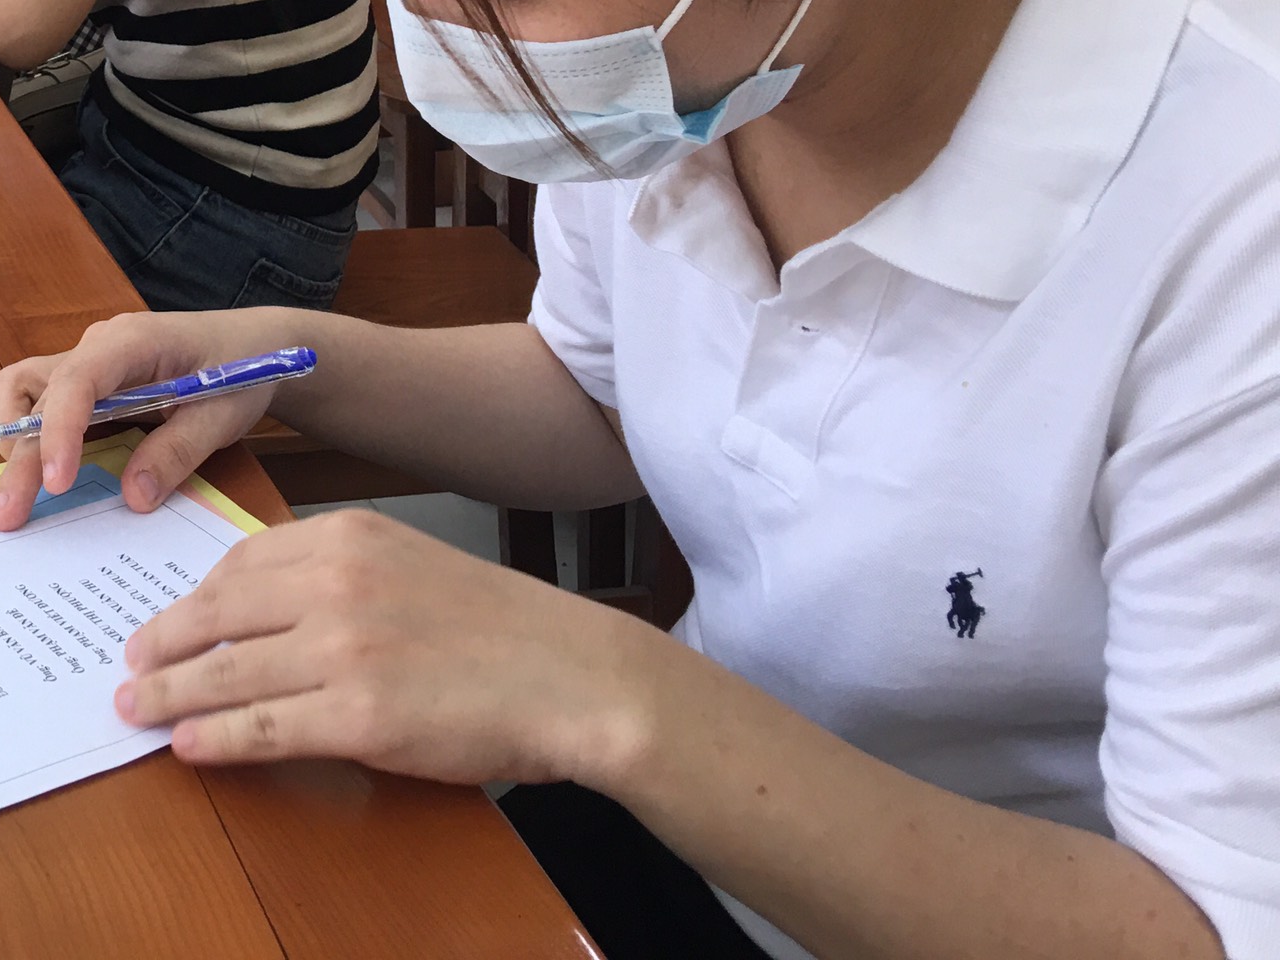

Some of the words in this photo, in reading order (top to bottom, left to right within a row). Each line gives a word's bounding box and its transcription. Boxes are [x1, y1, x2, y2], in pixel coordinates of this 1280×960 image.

[142, 570, 162, 586] VĂN
[164, 561, 190, 579] VINH
[48, 582, 88, 612] PHƯỢNG
[99, 593, 123, 613] XUÂN
[82, 610, 103, 624] THỊ
[21, 618, 40, 635] VĂN
[5, 636, 25, 654] VĂN
[36, 633, 67, 657] PHẠM
[63, 624, 95, 648] PHẠM
[19, 653, 38, 666] VŨ
[64, 655, 86, 674] Ông:
[91, 646, 113, 665] Ông:
[36, 664, 58, 682] Ông:
